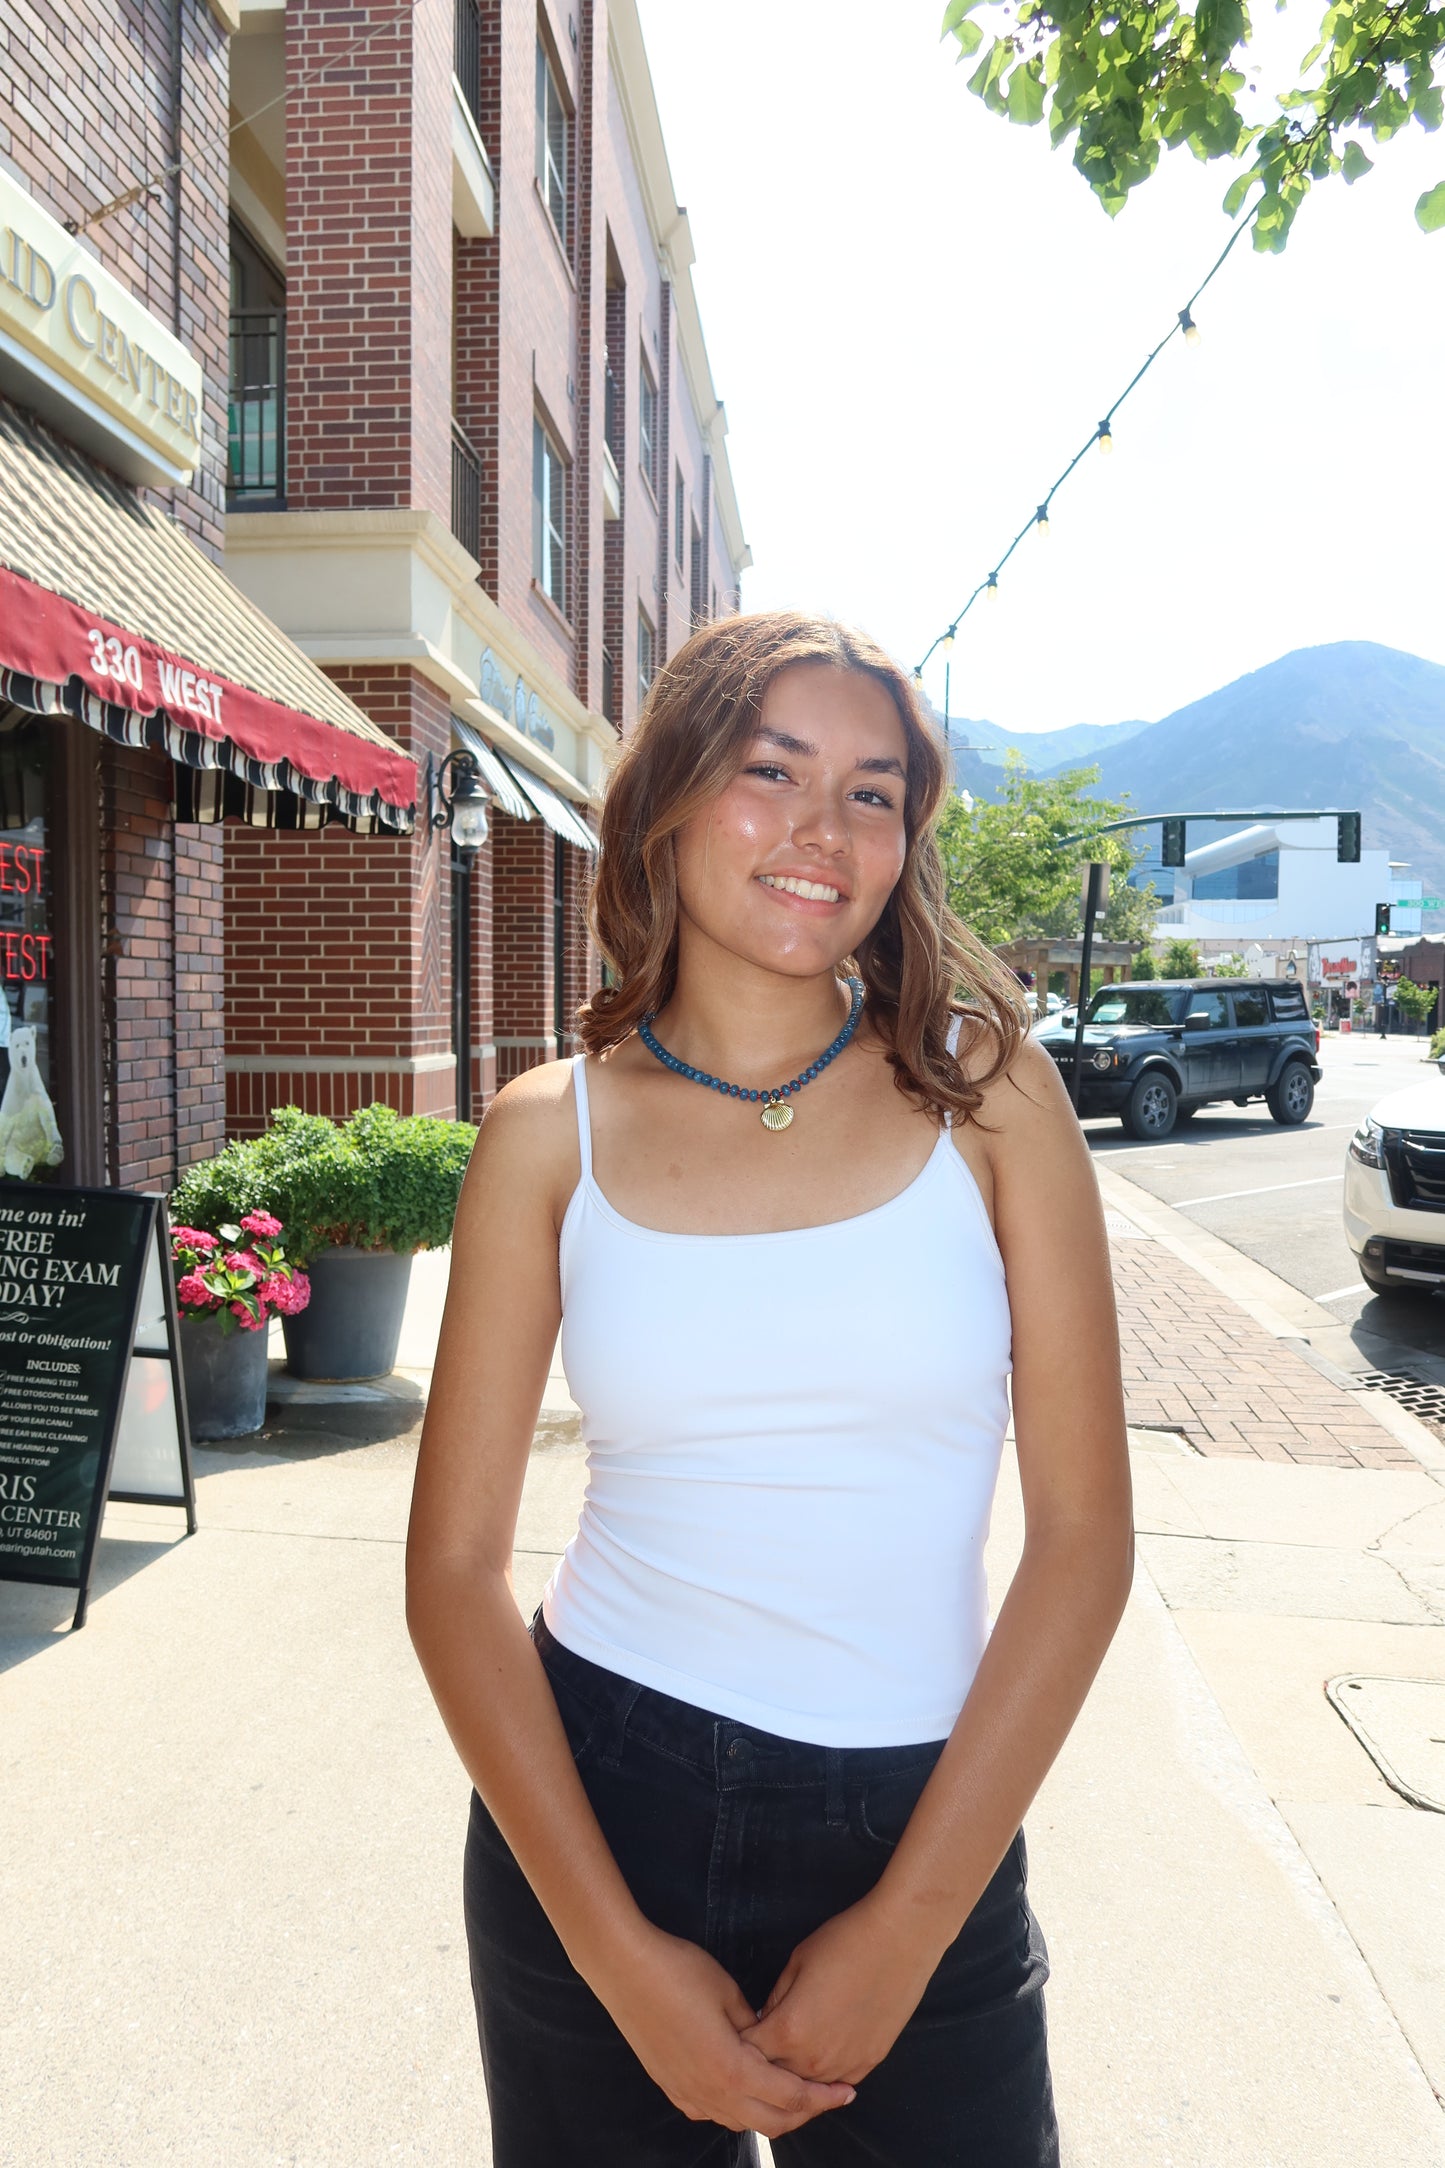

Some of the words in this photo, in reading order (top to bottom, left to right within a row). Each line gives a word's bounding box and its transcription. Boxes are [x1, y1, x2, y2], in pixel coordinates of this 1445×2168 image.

[0, 226, 56, 312] ID
[88, 628, 142, 692] 330
[157, 659, 223, 725] WEST
[28, 1210, 52, 1225] on
[57, 1209, 86, 1227] in!
[43, 1259, 121, 1286] EXAM
[0, 1282, 65, 1308] DAY!
[19, 1332, 35, 1343] Or
[37, 1333, 112, 1350] Obligation!
[26, 1360, 81, 1374] INCLUDES:
[7, 1374, 24, 1382] FREE
[25, 1376, 58, 1386] HEARING
[58, 1379, 78, 1387] TEST!
[4, 1387, 21, 1396] FREE
[23, 1389, 65, 1400] OTOSCOPIC
[65, 1393, 89, 1402] EXAM!
[1, 1401, 32, 1410] ALLOWS
[33, 1404, 48, 1412] YOU
[49, 1405, 60, 1413] TO
[15, 1429, 30, 1437] EAR
[48, 1432, 88, 1442] CLEANING!
[13, 1443, 45, 1452] HEARING
[46, 1446, 59, 1454] AID
[1, 1505, 81, 1528] CENTER
[7, 1527, 23, 1538] UT
[24, 1528, 58, 1541] 84601
